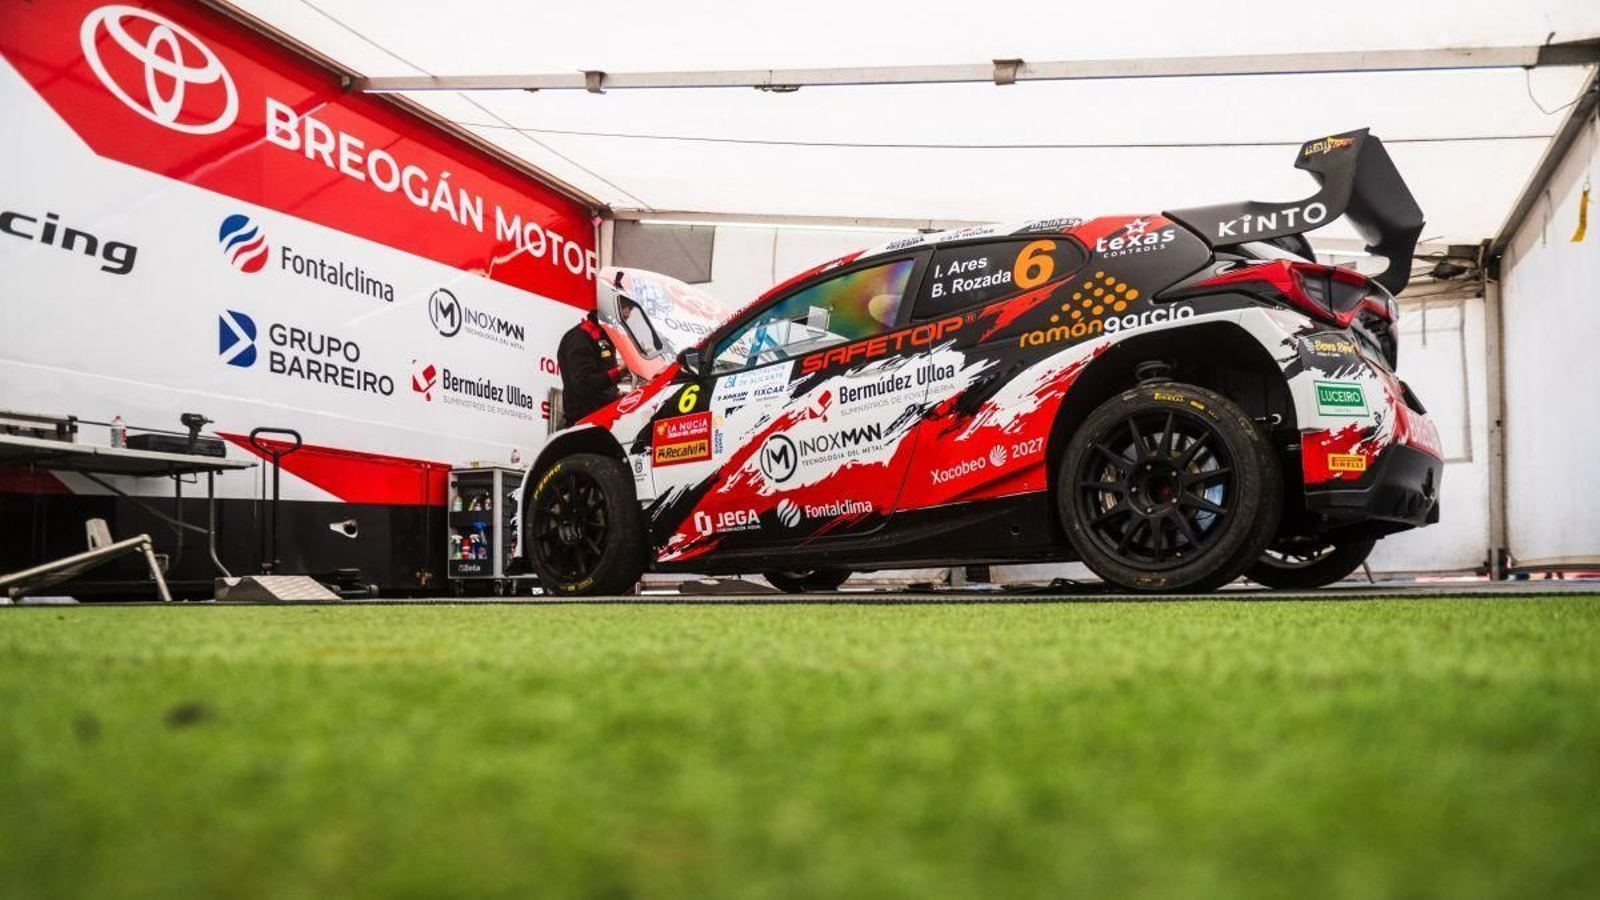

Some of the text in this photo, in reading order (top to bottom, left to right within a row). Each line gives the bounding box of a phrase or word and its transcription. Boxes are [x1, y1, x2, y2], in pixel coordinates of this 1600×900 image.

[266, 97, 484, 232] BREOGÁN
[0, 212, 137, 276] cing
[1096, 229, 1175, 253] texas
[1103, 243, 1167, 258] CONTROLS
[281, 246, 394, 302] Fontalclima
[933, 257, 988, 279] I. Ares
[1013, 239, 1057, 289] 6
[931, 270, 1012, 298] B. Rozada
[464, 306, 525, 341] INOXMAN
[269, 323, 360, 363] GRUPO
[269, 351, 394, 396] BARREIRO
[839, 364, 955, 405] Bermúdez Ulloa
[443, 369, 504, 402] Bermúdez
[506, 385, 533, 410] Ulloa
[678, 384, 700, 414] 6
[753, 385, 785, 397] FIXCAR
[890, 396, 902, 406] DE
[1320, 390, 1361, 403] LUCEIRO
[799, 422, 882, 457] INOXMAN
[847, 448, 859, 457] DEL
[1011, 437, 1044, 460] 2027
[805, 499, 873, 519] Fontalclima
